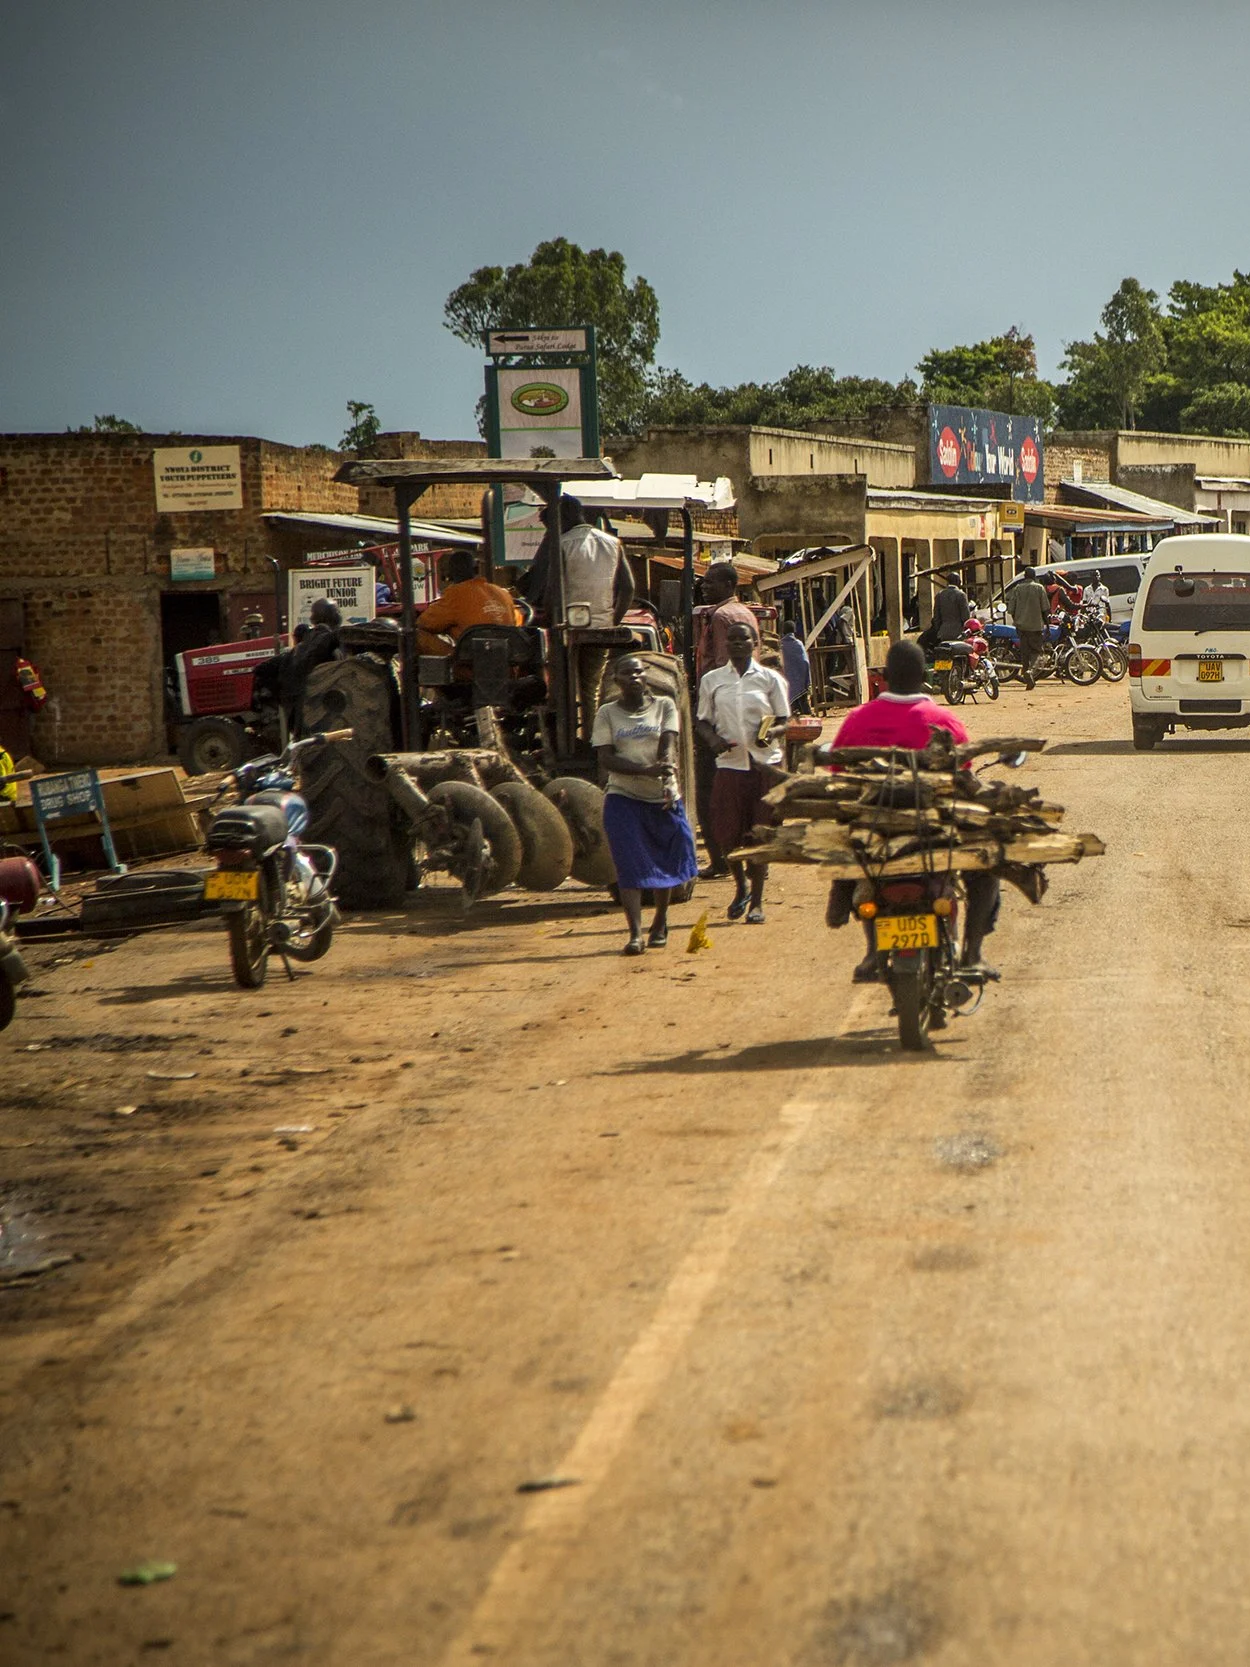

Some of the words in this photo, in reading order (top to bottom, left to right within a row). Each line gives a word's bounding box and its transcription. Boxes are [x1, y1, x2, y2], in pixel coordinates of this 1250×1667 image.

[191, 465, 231, 473] DISTRICT
[160, 474, 186, 482] YOUTH
[186, 473, 237, 481] PUPPETEERS
[300, 578, 331, 589] BRIGHT
[332, 577, 363, 588] FUTURE
[326, 588, 357, 598] JUNIOR
[1206, 663, 1221, 671] UAV
[1201, 672, 1220, 680] 097H
[897, 916, 927, 932] UDS
[891, 932, 930, 949] 297D
